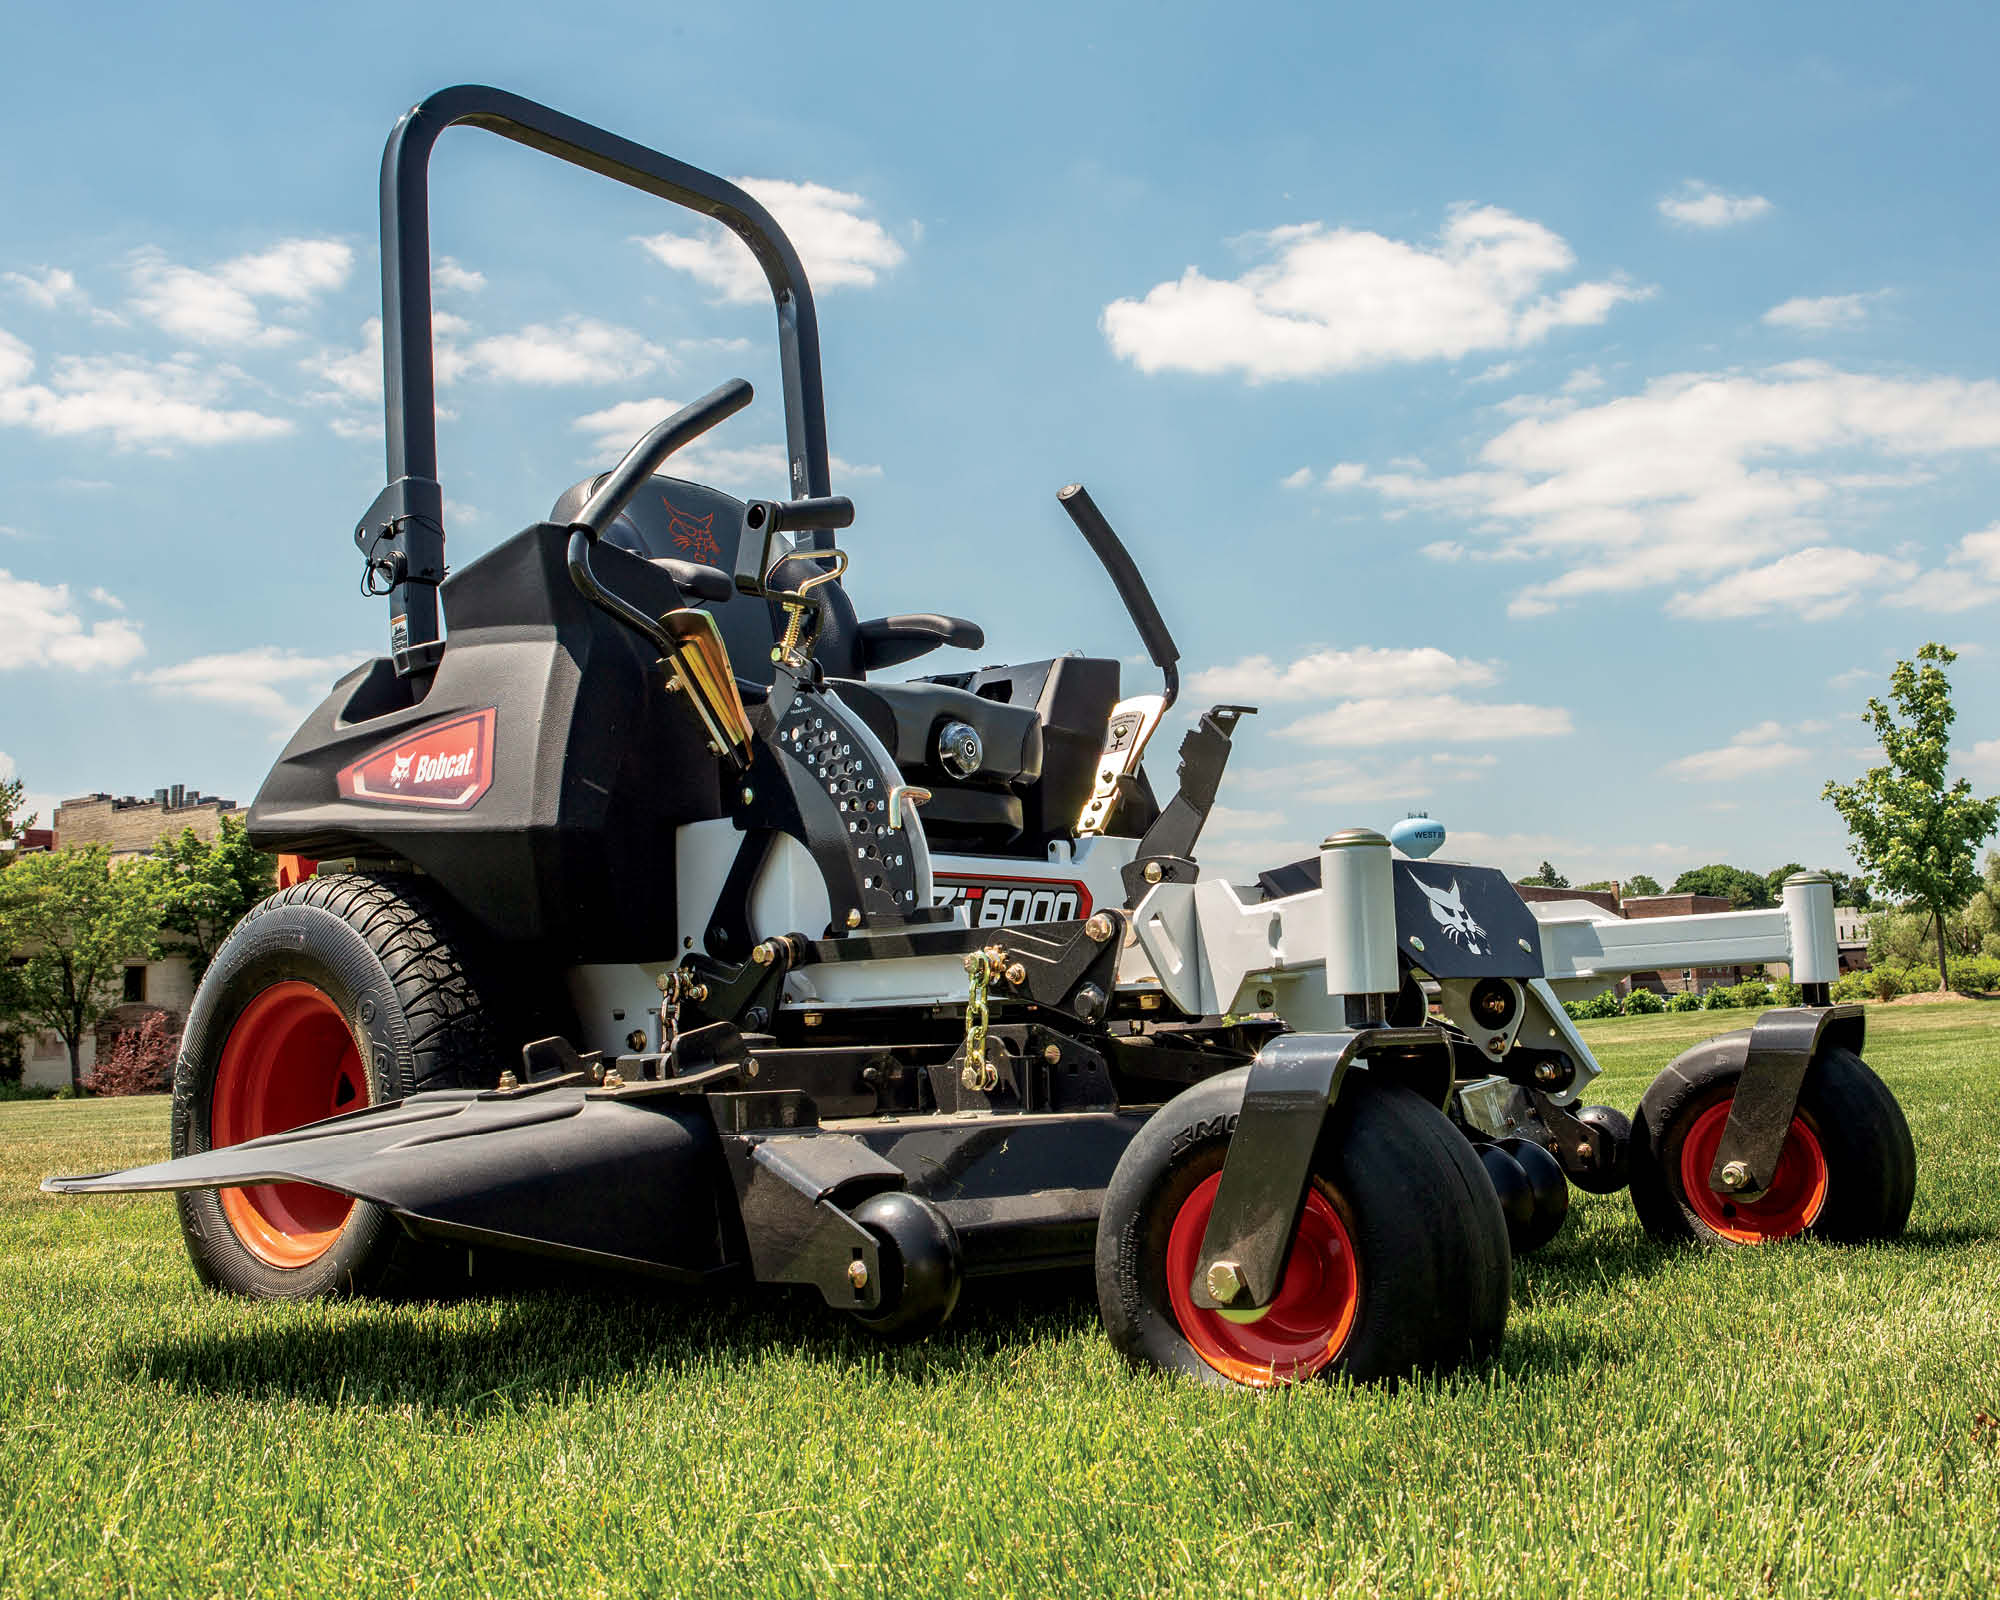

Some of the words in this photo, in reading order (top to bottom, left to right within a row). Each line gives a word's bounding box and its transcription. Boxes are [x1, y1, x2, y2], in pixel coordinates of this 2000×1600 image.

[414, 748, 474, 784] Bobcat
[1414, 831, 1437, 839] WEST
[978, 888, 1079, 928] 6000
